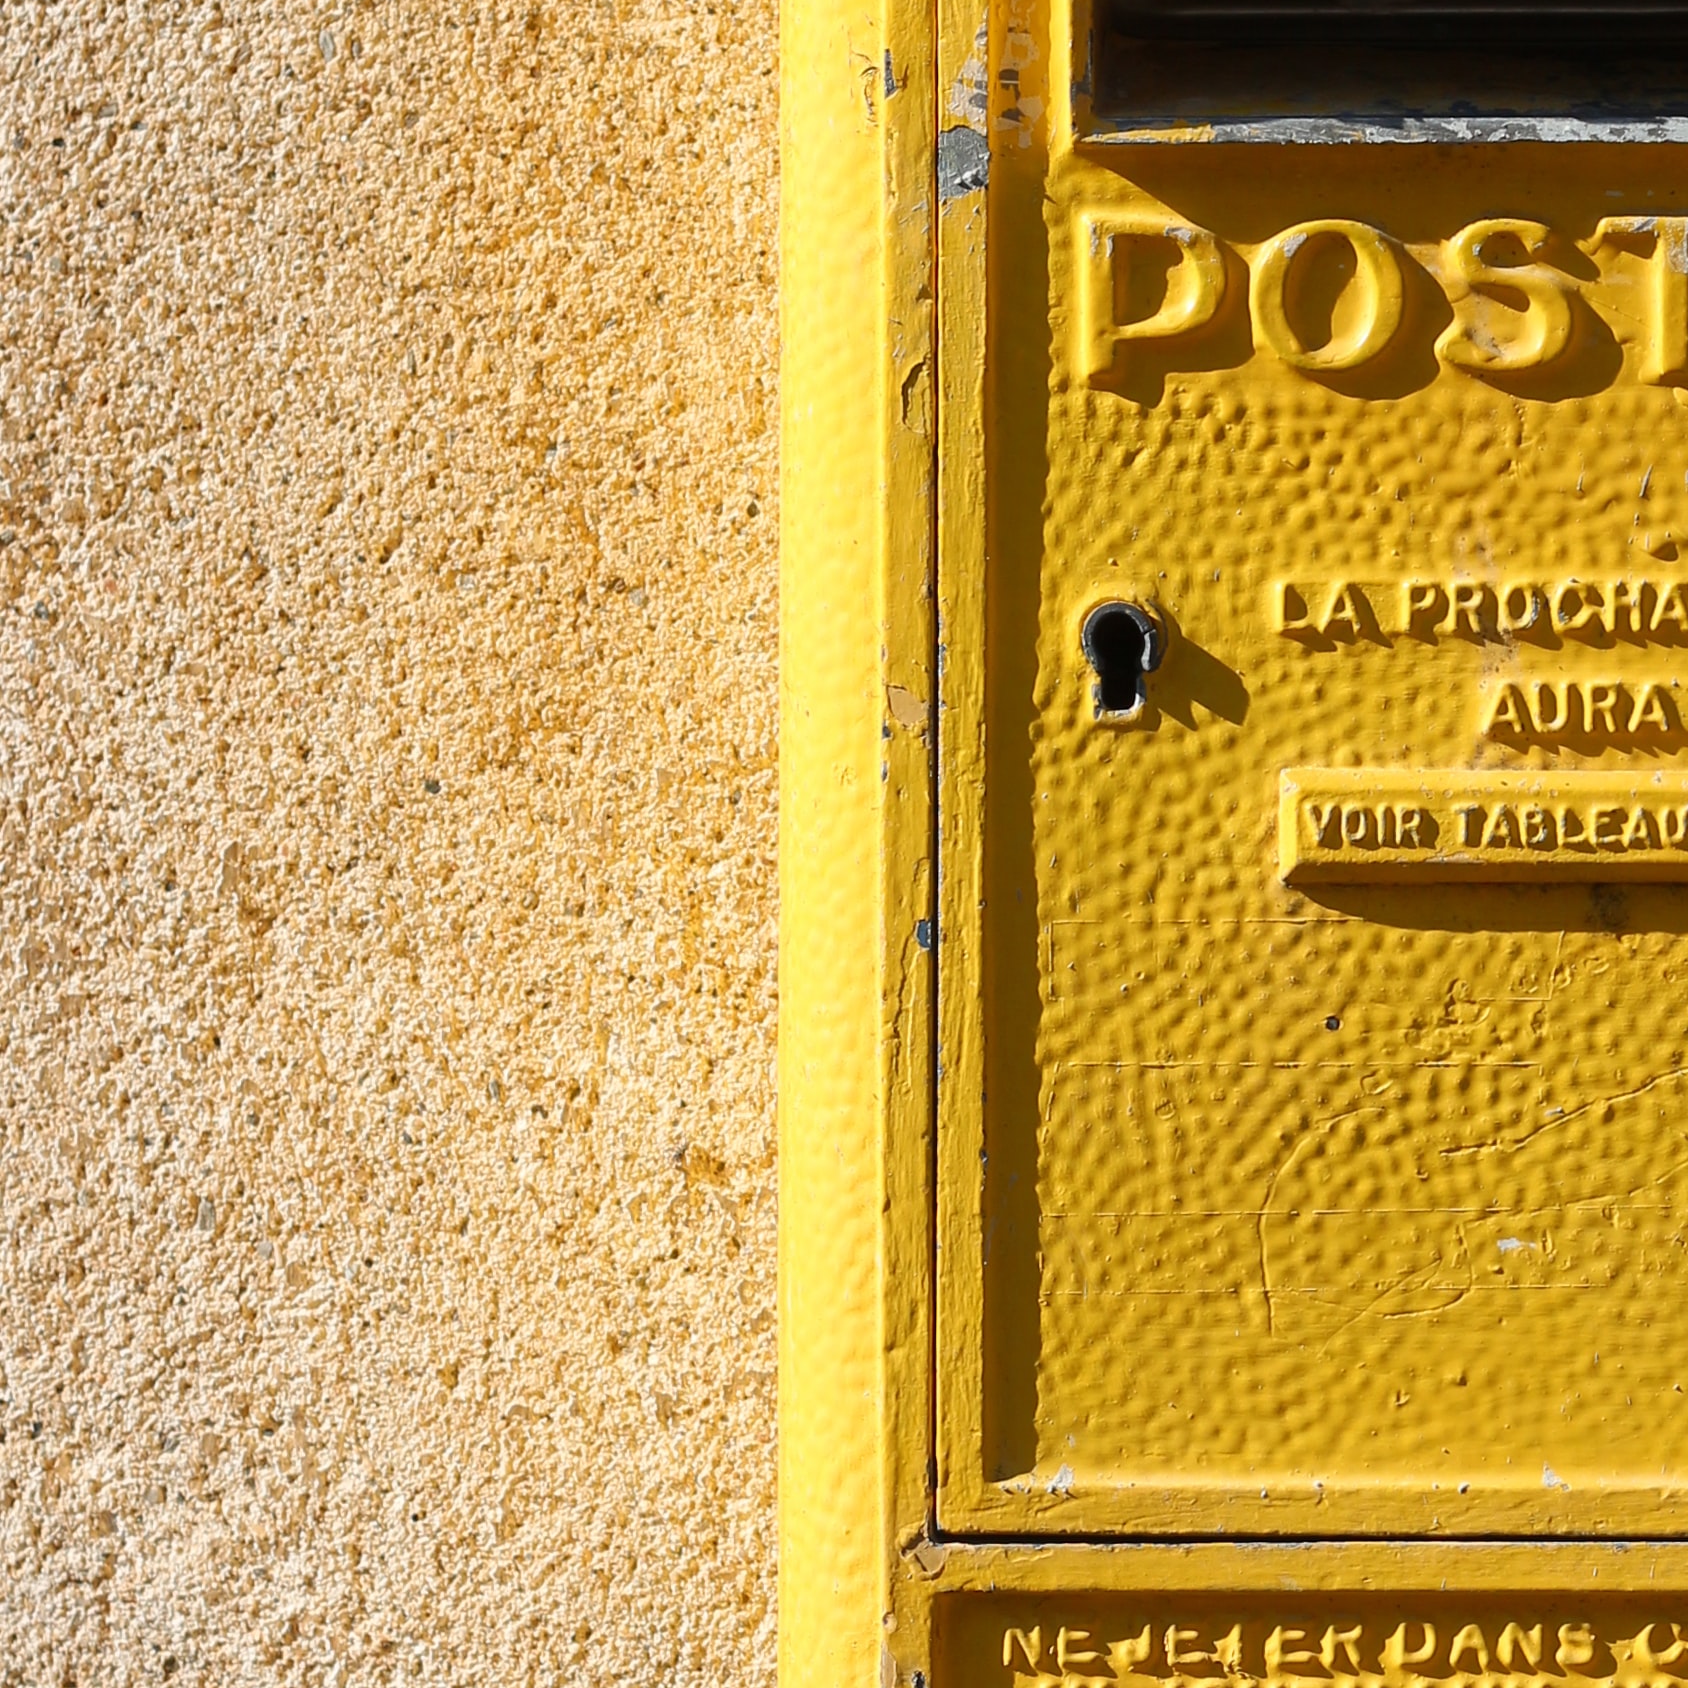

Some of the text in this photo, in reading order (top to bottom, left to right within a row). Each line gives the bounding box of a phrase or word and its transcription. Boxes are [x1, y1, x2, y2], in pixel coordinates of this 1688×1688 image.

[1274, 581, 1361, 634] LA
[1483, 682, 1668, 733] AURA
[1306, 803, 1422, 846] VOIR
[1002, 1623, 1102, 1667] NE
[1116, 1623, 1364, 1672] JETER
[1397, 1622, 1594, 1668] DANS
